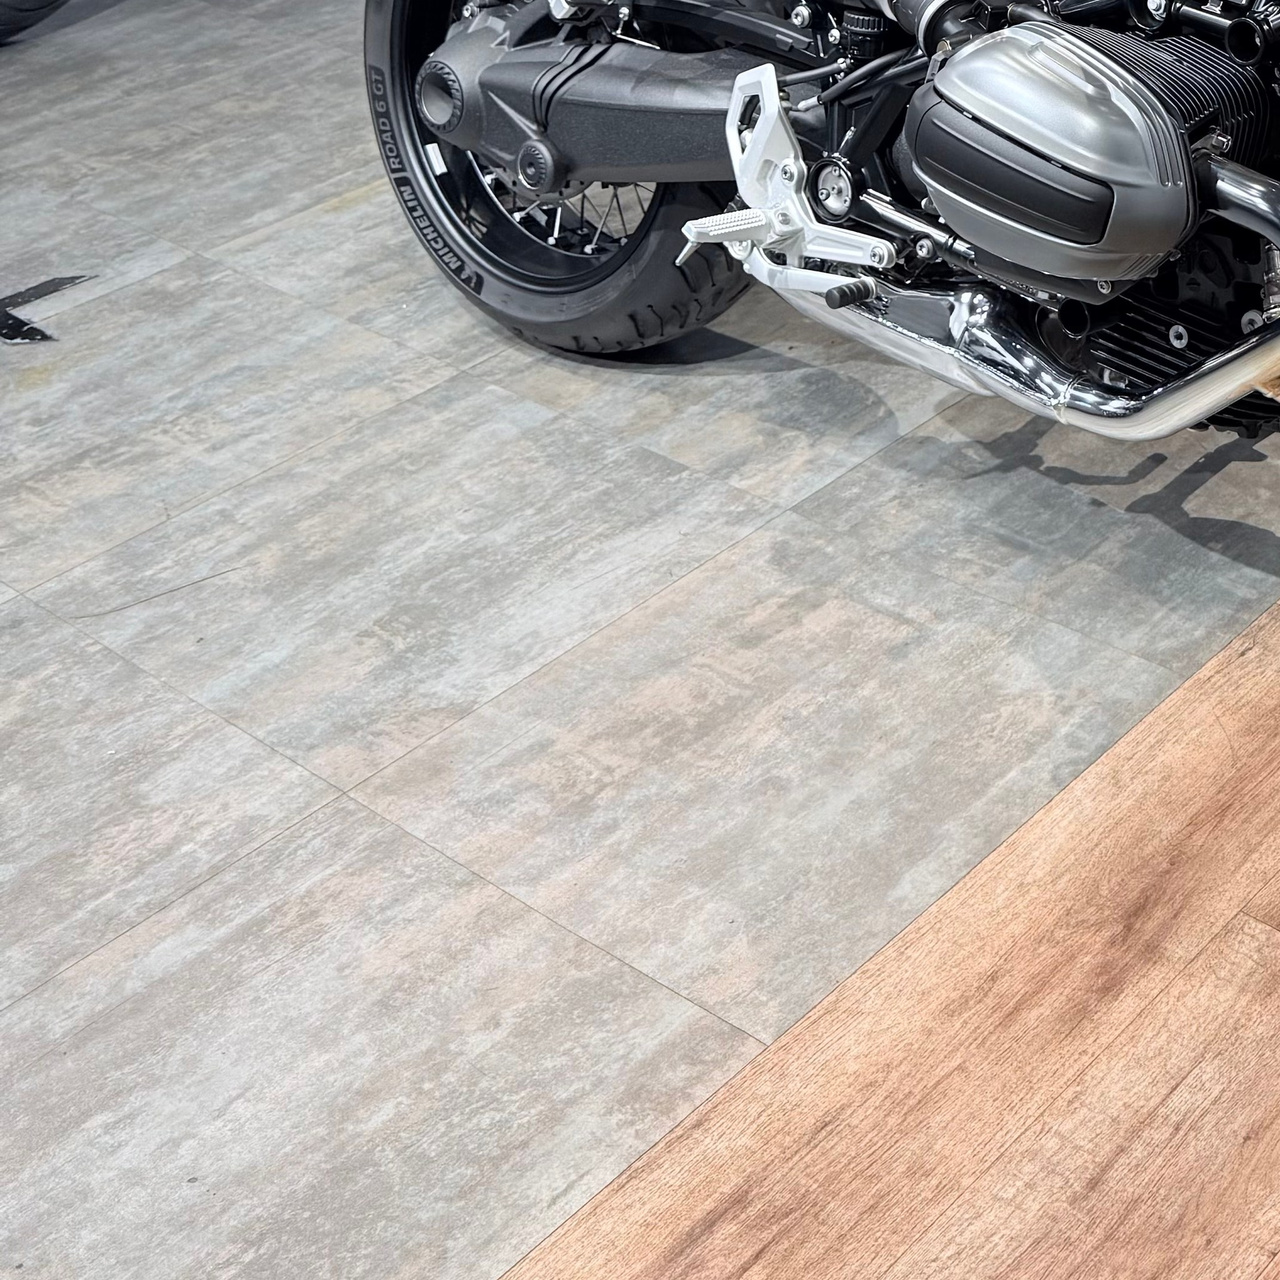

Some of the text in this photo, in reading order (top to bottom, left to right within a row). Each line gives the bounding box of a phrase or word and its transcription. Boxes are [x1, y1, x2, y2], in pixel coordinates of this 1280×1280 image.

[371, 70, 402, 169] ROAD 6 GT
[400, 185, 461, 272] MICHELIN
